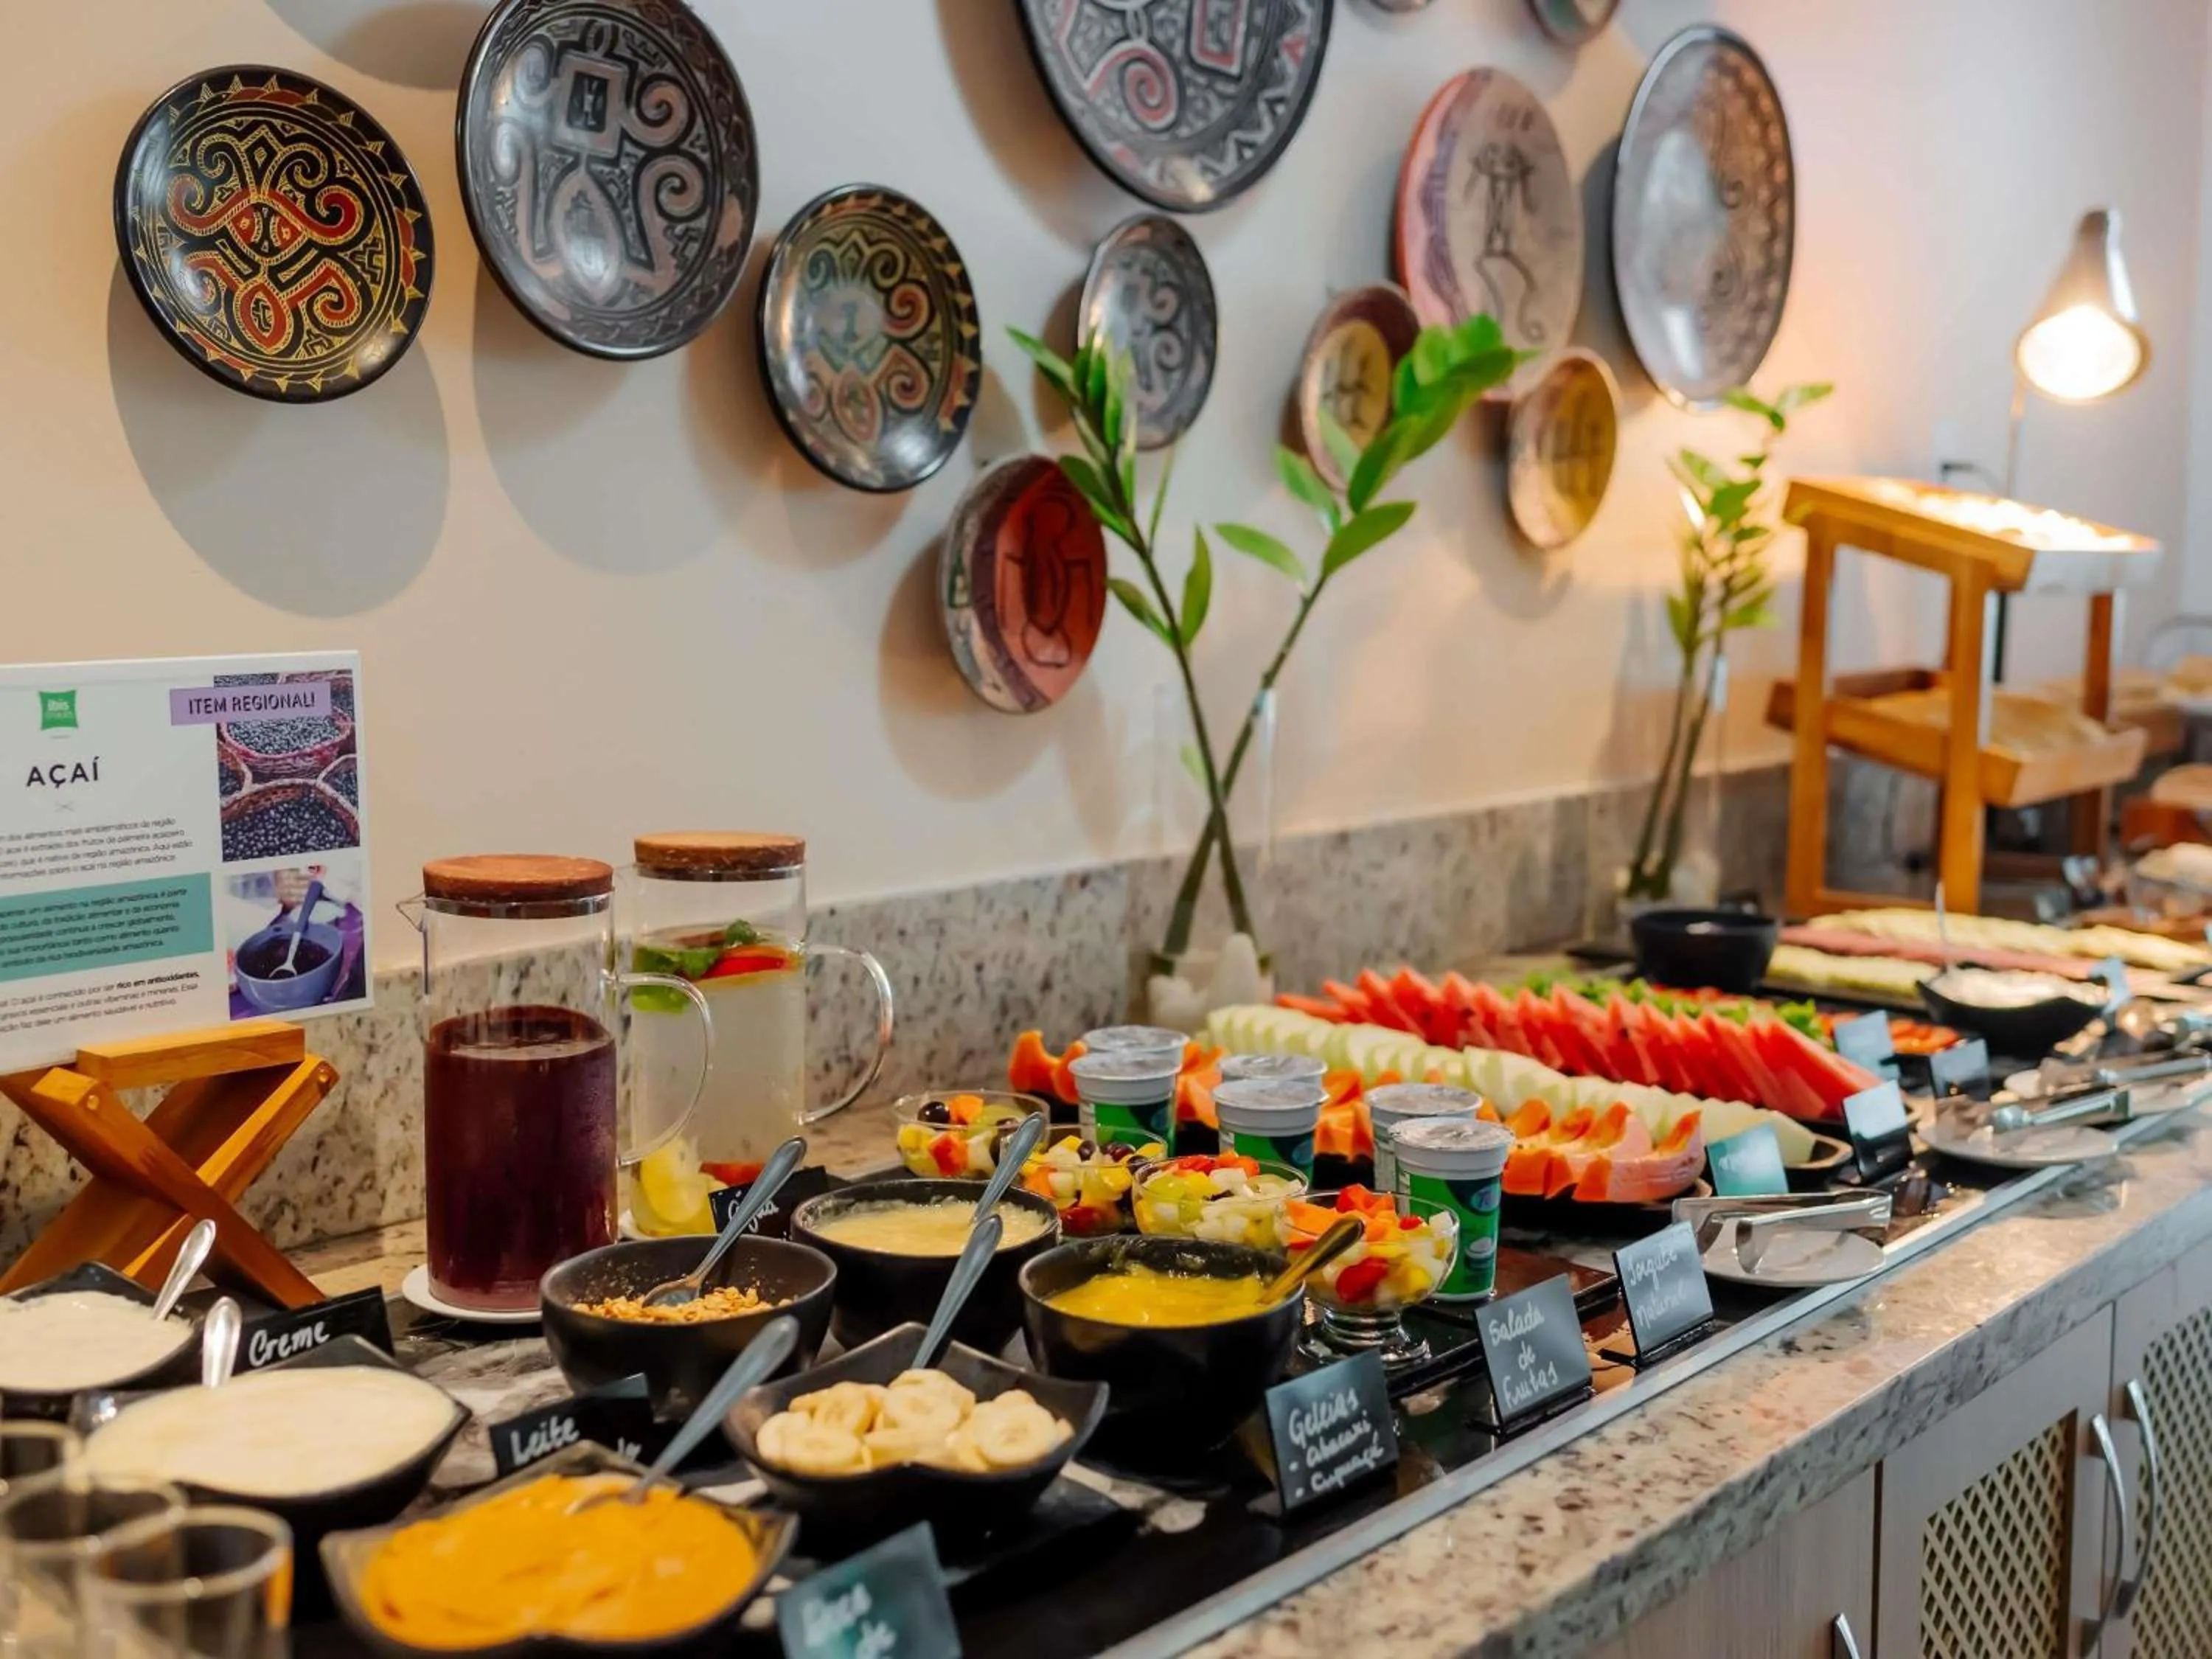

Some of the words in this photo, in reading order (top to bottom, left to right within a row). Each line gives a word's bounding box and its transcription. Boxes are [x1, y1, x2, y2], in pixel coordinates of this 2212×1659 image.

[188, 697, 227, 715] ITEM
[232, 691, 316, 712] REGIONAL!
[27, 756, 100, 788] AÇAÍ
[248, 1321, 331, 1368] Creme
[1489, 1300, 1545, 1347] Salada
[1518, 1340, 1537, 1371] de
[1502, 1360, 1559, 1410] Frutas
[510, 1415, 580, 1467] Leite
